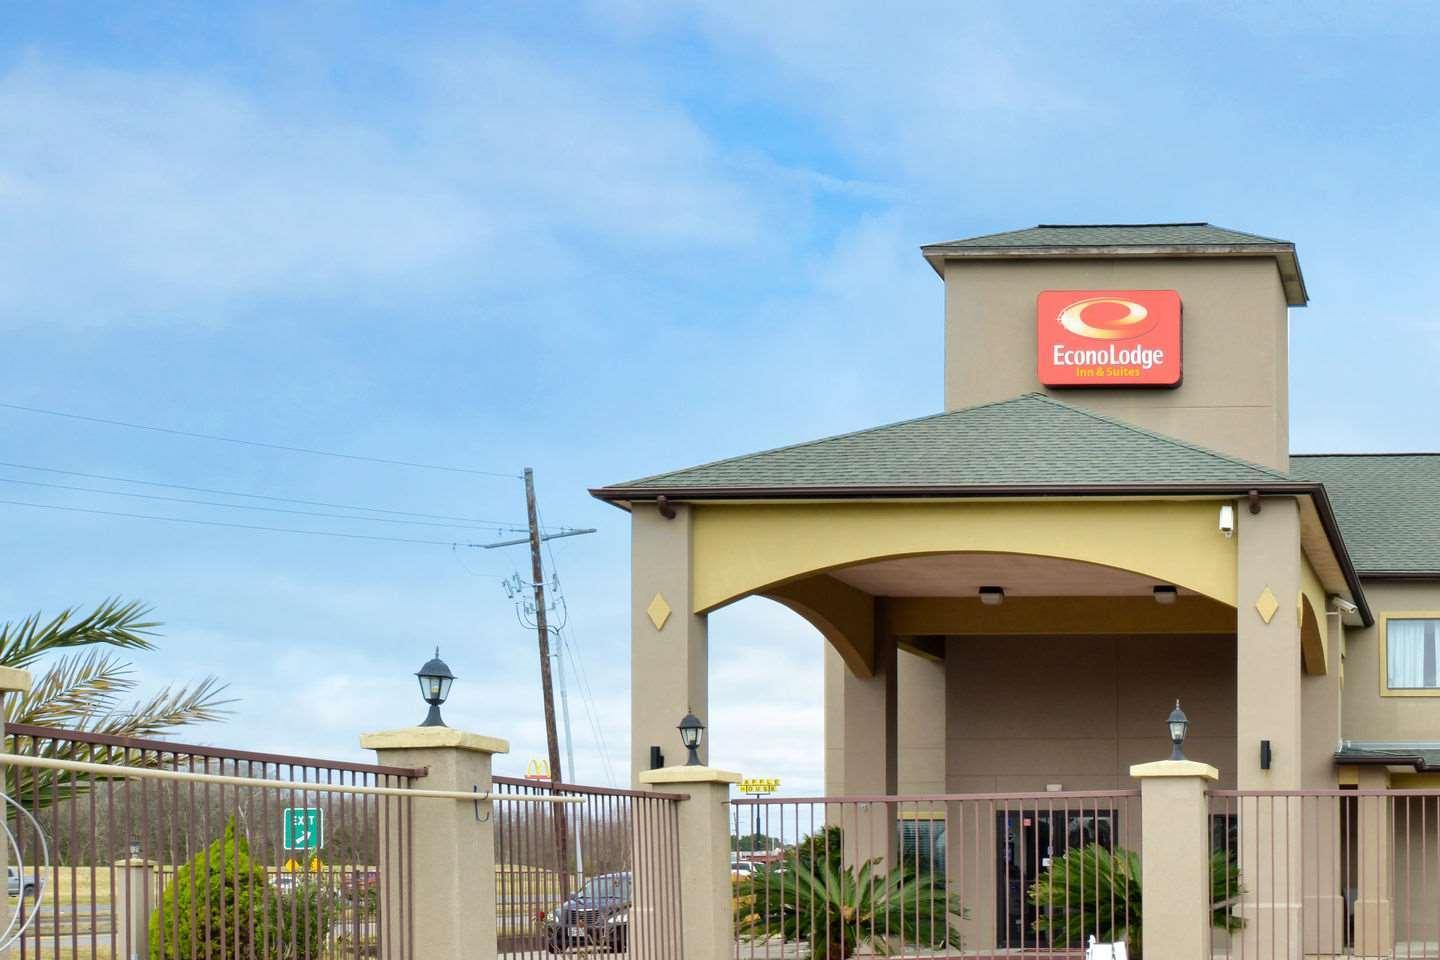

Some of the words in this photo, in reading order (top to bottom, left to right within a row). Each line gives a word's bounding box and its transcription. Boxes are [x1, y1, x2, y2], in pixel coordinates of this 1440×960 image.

[1053, 344, 1164, 369] EconoLodge
[1077, 367, 1093, 377] Inn
[1096, 367, 1104, 377] &
[1107, 367, 1140, 377] Suites
[292, 816, 315, 826] EXT
